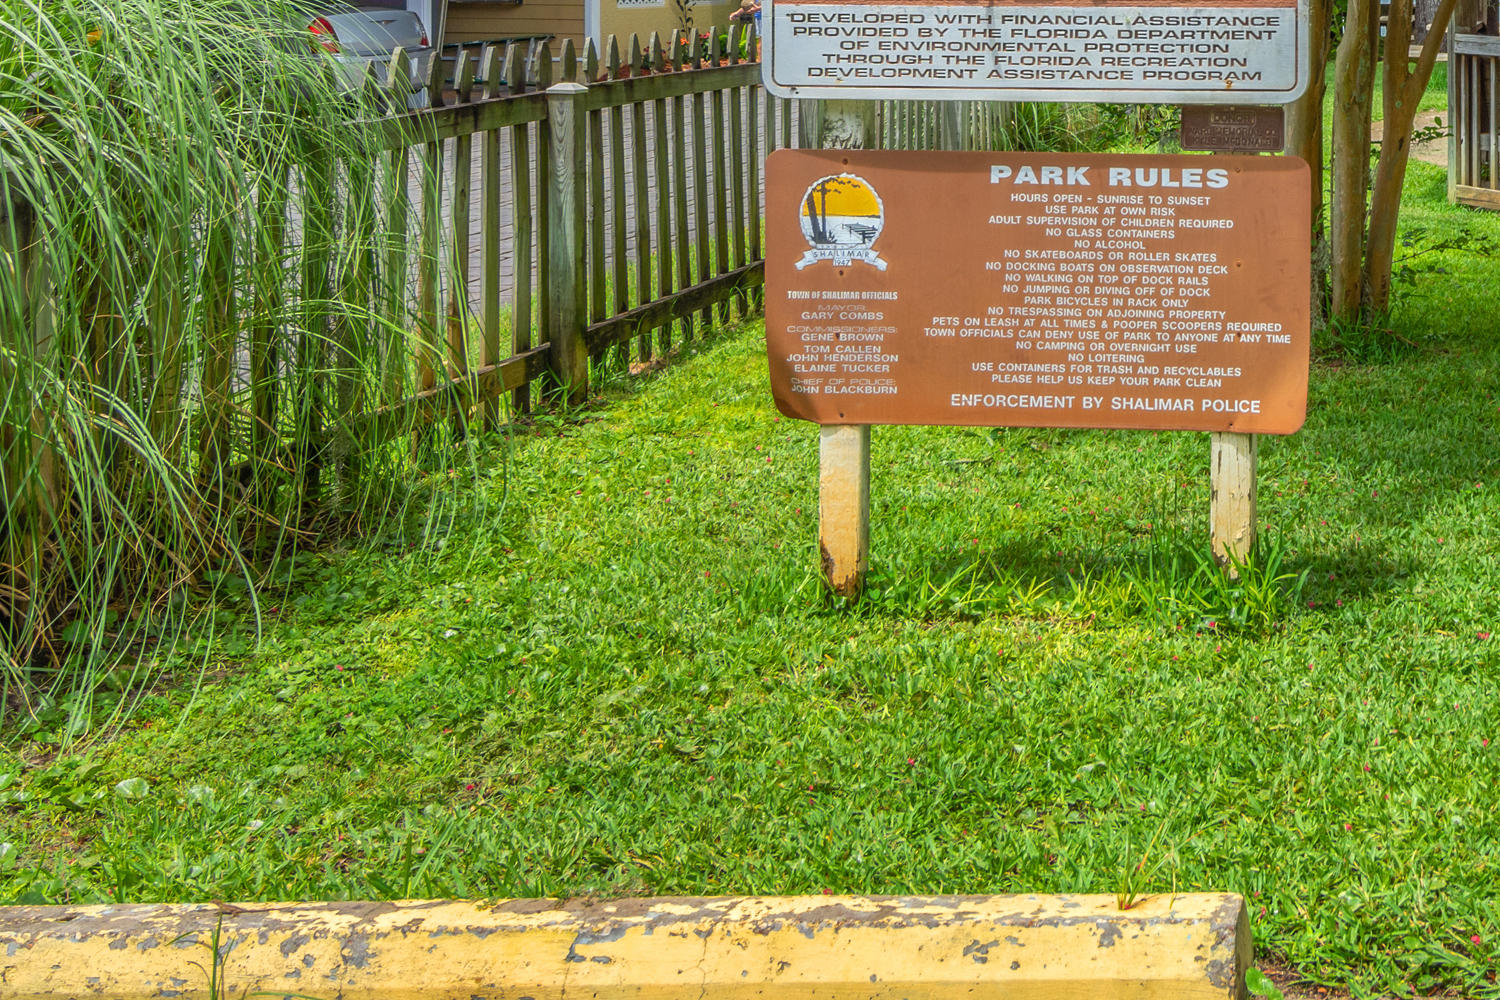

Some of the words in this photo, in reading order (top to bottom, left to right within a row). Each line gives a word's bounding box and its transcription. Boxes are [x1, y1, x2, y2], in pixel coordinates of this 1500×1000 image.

[789, 13, 924, 24] DEVELOPED
[934, 14, 991, 24] WITH
[1001, 14, 1123, 25] FINANCIAL
[1132, 15, 1279, 26] ASSISTANCE
[793, 27, 908, 38] PROVIDED
[917, 28, 948, 38] BY
[958, 28, 1001, 38] THE
[1010, 28, 1107, 39] FLORIDA
[1117, 29, 1276, 40] DEPARTMENT
[839, 41, 868, 51] OF
[878, 41, 1075, 52] ENVIRONMENTAL
[1084, 42, 1228, 53] PROTECTION
[822, 54, 932, 65] THROUGH
[941, 55, 984, 65] THE
[994, 55, 1091, 66] FLORIDA
[1100, 56, 1246, 67] RECREATION
[807, 67, 977, 78] DEVELOPMENT
[986, 69, 1133, 79] ASSISTANCE
[1142, 70, 1261, 80] PROGRAM
[990, 165, 1091, 186] PARK
[1109, 167, 1228, 189] RULES
[1010, 193, 1048, 203] HOURS
[1052, 194, 1082, 204] OPEN
[1096, 194, 1143, 205] SUNRISE
[1148, 195, 1162, 205] TO
[1167, 196, 1210, 206] SUNSET
[1045, 205, 1066, 214] USE
[1071, 206, 1098, 215] PARK
[1103, 206, 1115, 215] AT
[1120, 207, 1145, 215] OWN
[1150, 207, 1174, 216] RISK
[988, 216, 1021, 225] ADULT
[1026, 216, 1096, 226] SUPERVISION
[1101, 218, 1115, 227] OF
[1120, 218, 1174, 228] CHILDREN
[1178, 219, 1233, 229] REQUIRED
[1045, 228, 1061, 237] NO
[1066, 228, 1102, 238] GLASS
[1107, 229, 1174, 239] CONTAINERS
[1074, 240, 1090, 249] NO
[1094, 240, 1145, 250] ALCOHOL
[813, 250, 870, 258] SHALIMAR
[1004, 250, 1020, 259] NO
[1024, 250, 1103, 260] SKATEBOARDS
[1108, 252, 1123, 261] OR
[1128, 252, 1169, 261] ROLLER
[1174, 253, 1216, 262] SKATES
[985, 262, 1001, 271] NO
[1006, 262, 1055, 271] DOCKING
[1060, 263, 1094, 272] BOATS
[1099, 263, 1114, 272] ON
[1119, 264, 1193, 274] OBSERVATION
[1198, 265, 1227, 274] DECK
[1005, 274, 1020, 282] NO
[1025, 274, 1072, 283] WALKING
[1077, 275, 1093, 283] ON
[1098, 275, 1118, 284] TOP
[1122, 275, 1137, 284] OF
[1141, 276, 1172, 285] DOCK
[1177, 276, 1208, 285] RAILS
[787, 290, 809, 299] TOWN
[811, 291, 820, 300] OF
[822, 291, 859, 300] SHALIMAR
[861, 291, 897, 300] OFFICIALS
[1002, 285, 1018, 293] NO
[1022, 285, 1069, 294] JUMPING
[1074, 286, 1089, 294] OR
[1094, 286, 1130, 295] DIVING
[1134, 287, 1155, 296] OFF
[1160, 287, 1174, 296] OF
[1179, 287, 1210, 297] DOCK
[1024, 296, 1050, 305] PARK
[1056, 297, 1107, 306] BICYCLES
[1112, 298, 1123, 306] IN
[1127, 298, 1156, 307] RACK
[1161, 299, 1188, 308] ONLY
[801, 311, 833, 320] GARY
[839, 311, 883, 320] COMBS
[988, 307, 1003, 316] NO
[1009, 307, 1081, 317] TRESPASSING
[1086, 309, 1102, 317] ON
[1106, 309, 1164, 319] ADJOINING
[1169, 310, 1225, 320] PROPERTY
[932, 317, 959, 326] PETS
[964, 317, 980, 326] ON
[984, 318, 1018, 327] LEASH
[1023, 318, 1035, 327] AT
[1040, 319, 1058, 328] ALL
[1064, 319, 1095, 328] TIMES
[1100, 320, 1107, 329] &
[1113, 320, 1156, 329] POOPER
[1162, 321, 1221, 331] SCOOPERS
[1226, 322, 1281, 332] REQUIRED
[801, 333, 833, 341] GENE
[839, 333, 883, 341] BROWN
[924, 328, 955, 337] TOWN
[959, 328, 1013, 338] OFFICIALS
[1018, 329, 1040, 339] CAN
[1045, 330, 1073, 339] DENY
[1078, 331, 1099, 340] USE
[1104, 331, 1118, 340] OF
[1123, 332, 1150, 341] PARK
[1155, 332, 1169, 341] TO
[1174, 332, 1217, 342] ANYONE
[1222, 333, 1236, 343] AT
[1239, 334, 1261, 343] ANY
[1266, 334, 1290, 344] TIME
[804, 345, 830, 353] TOM
[835, 345, 880, 353] CALLEN
[1016, 341, 1031, 350] NO
[1036, 341, 1084, 351] CAMPING
[1089, 342, 1104, 351] OR
[1109, 343, 1170, 352] OVERNIGHT
[1175, 344, 1196, 353] USE
[786, 354, 818, 362] JOHN
[824, 354, 898, 362] HENDERSON
[1068, 353, 1084, 362] NO
[1088, 353, 1144, 363] LOITERING
[794, 364, 836, 372] ELAINE
[842, 364, 889, 373] TUCKER
[972, 363, 993, 372] USE
[998, 363, 1065, 373] CONTAINERS
[1070, 365, 1092, 374] FOR
[1097, 365, 1132, 375] TRASH
[1137, 366, 1158, 375] AND
[1163, 366, 1240, 377] RECYCLABLES
[991, 374, 1032, 384] PLEASE
[1036, 375, 1063, 385] HELP
[1068, 375, 1082, 385] US
[1087, 376, 1115, 385] KEEP
[1119, 376, 1148, 386] YOUR
[1153, 377, 1180, 387] PARK
[1185, 378, 1221, 387] CLEAN
[791, 385, 819, 393] JOHN
[824, 385, 897, 394] BLACKBURN
[951, 394, 1074, 409] ENFORCEMENT
[1082, 396, 1102, 410] BY
[1111, 397, 1193, 412] SHALIMAR
[1202, 399, 1260, 413] POLICE
